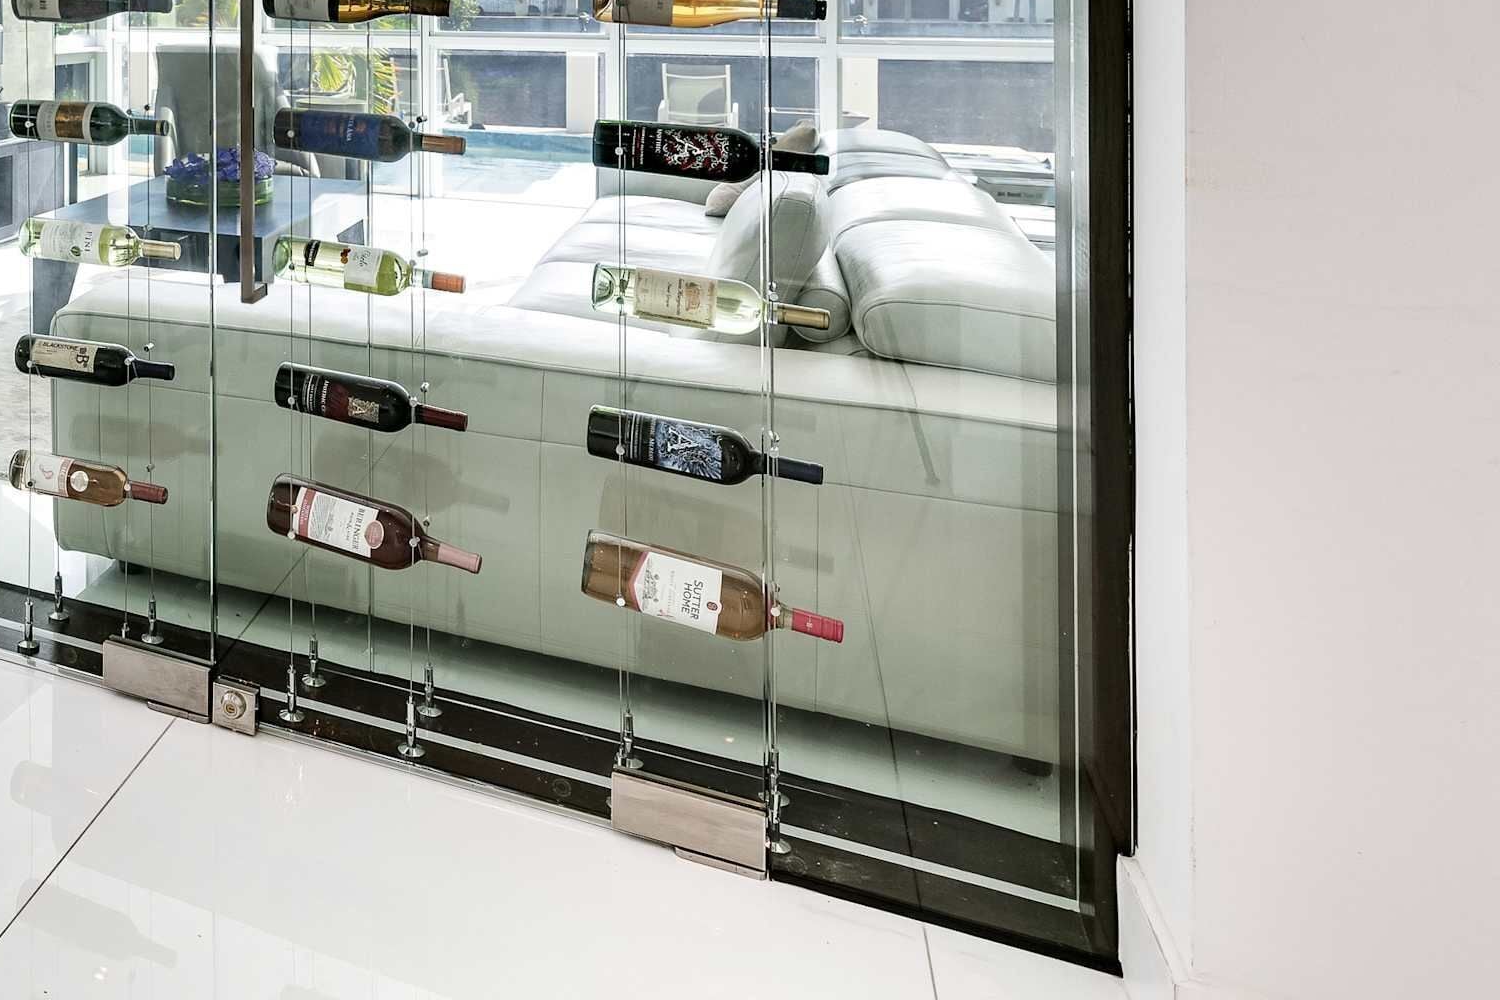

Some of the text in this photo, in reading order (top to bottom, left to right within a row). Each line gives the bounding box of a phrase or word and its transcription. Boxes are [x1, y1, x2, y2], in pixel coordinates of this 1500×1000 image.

[352, 508, 366, 551] BERINGER
[681, 582, 693, 614] HOME
[690, 580, 704, 620] SUTTER
